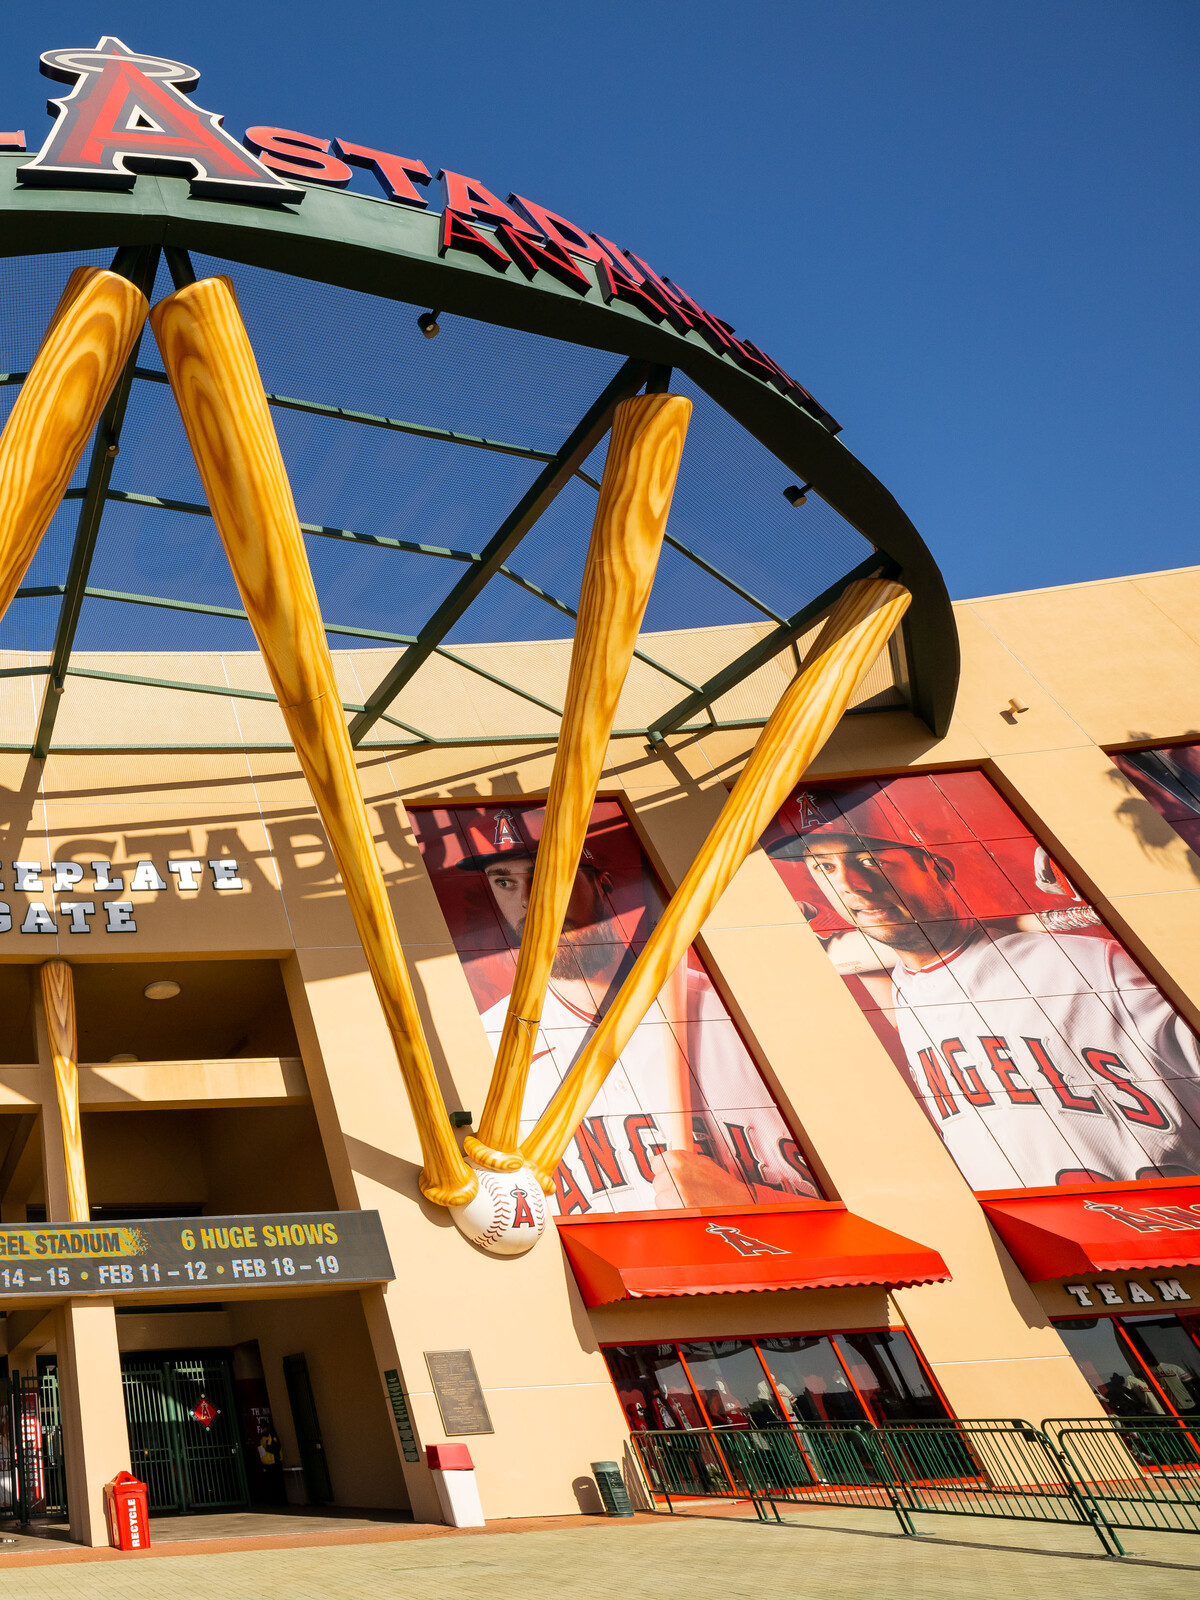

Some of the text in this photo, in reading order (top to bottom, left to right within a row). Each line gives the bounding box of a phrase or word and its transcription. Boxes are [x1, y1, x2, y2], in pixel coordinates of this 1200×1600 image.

[35, 1232, 121, 1254] STADIUM
[181, 1223, 339, 1250] 6 HUGE SHOWS
[1, 1268, 25, 1287] 14
[47, 1267, 70, 1286] 15
[99, 1264, 134, 1285] FEB
[139, 1263, 161, 1283] 11
[184, 1261, 208, 1280] 12
[231, 1258, 267, 1278] FEB
[271, 1257, 295, 1276] 18
[316, 1255, 339, 1275] 19
[1064, 1278, 1192, 1307] TEAM
[127, 1498, 141, 1548] RECYCLE
